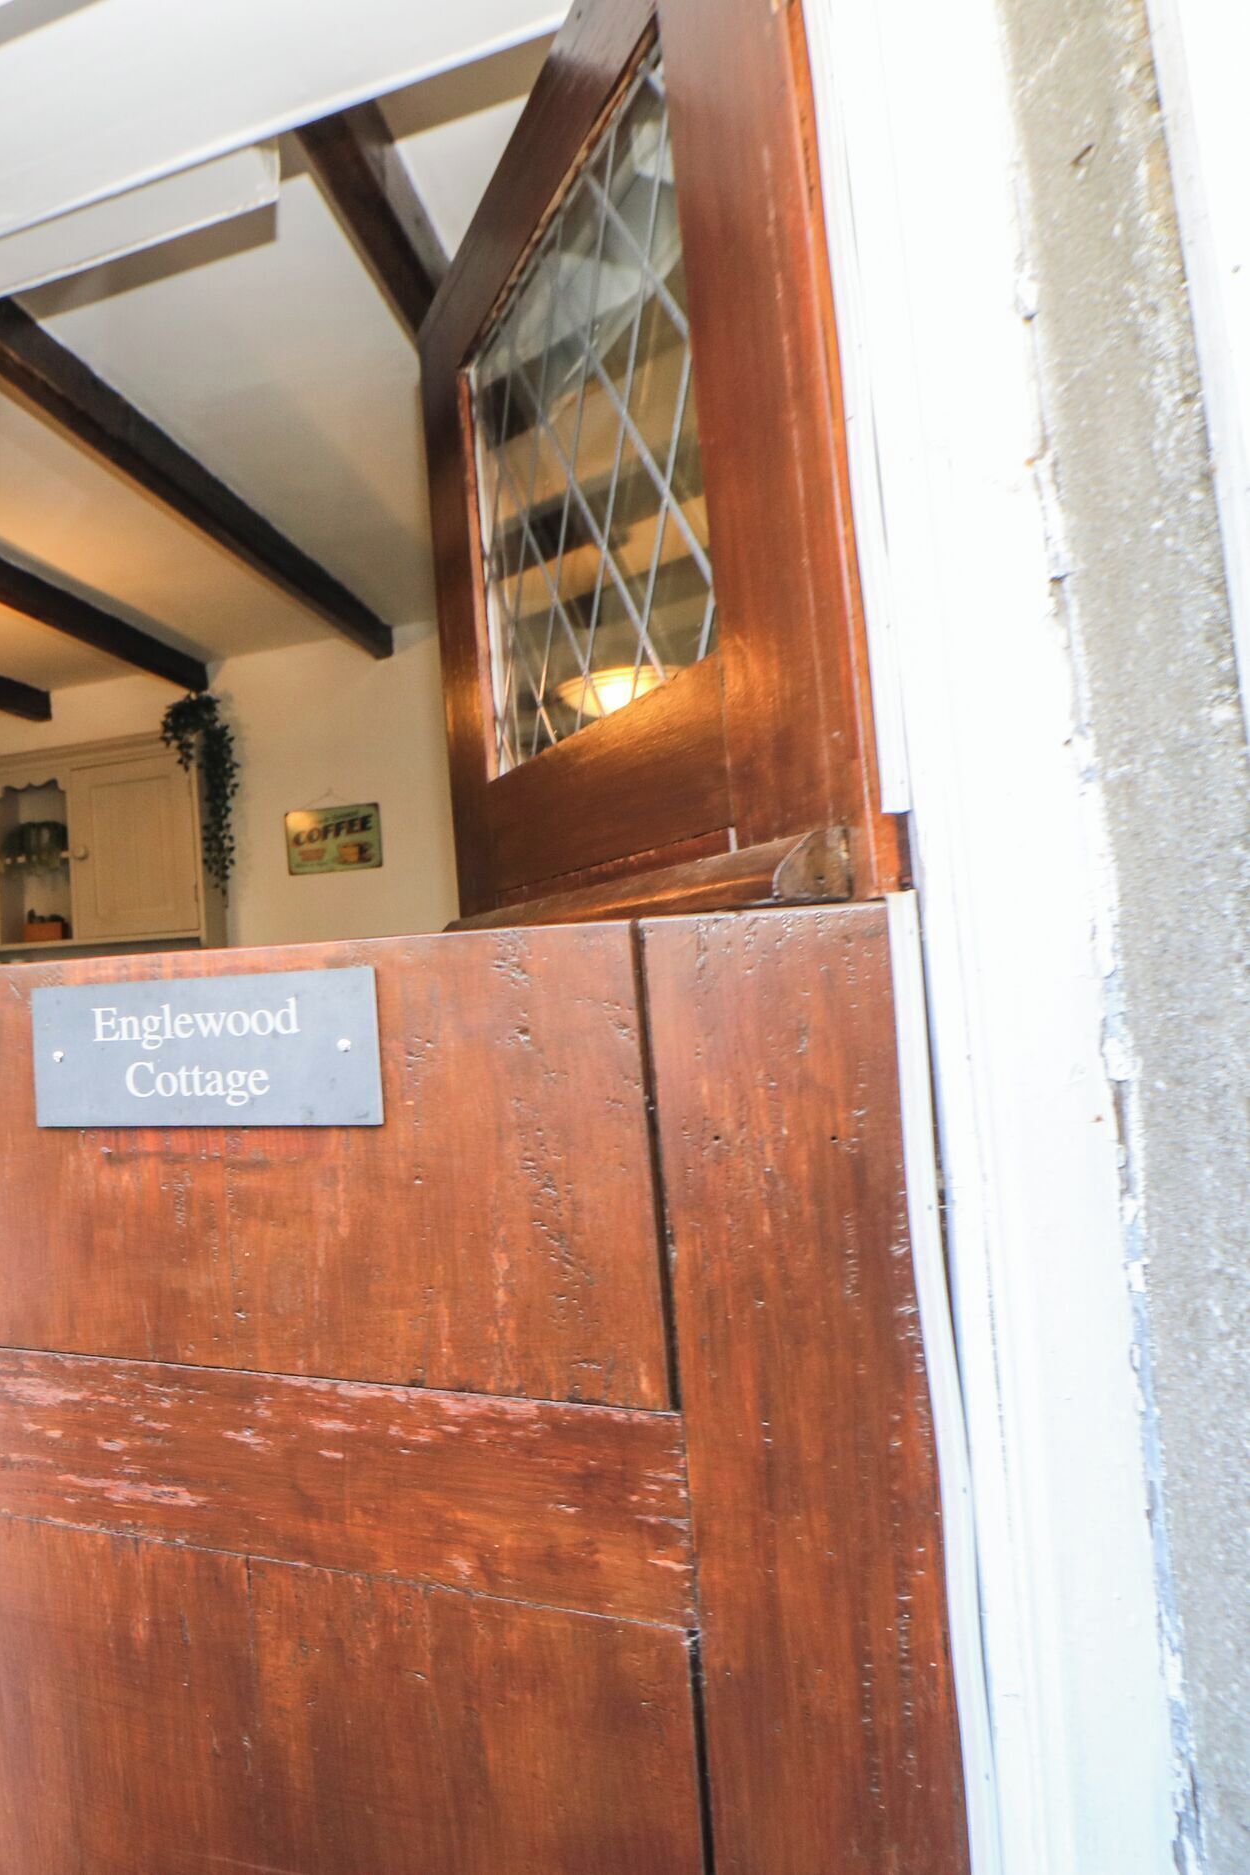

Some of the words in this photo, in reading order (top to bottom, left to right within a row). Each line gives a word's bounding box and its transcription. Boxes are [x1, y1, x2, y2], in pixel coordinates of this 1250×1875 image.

[293, 814, 373, 847] COFFEE
[91, 997, 301, 1050] Englewood
[125, 1061, 271, 1107] Cottage
